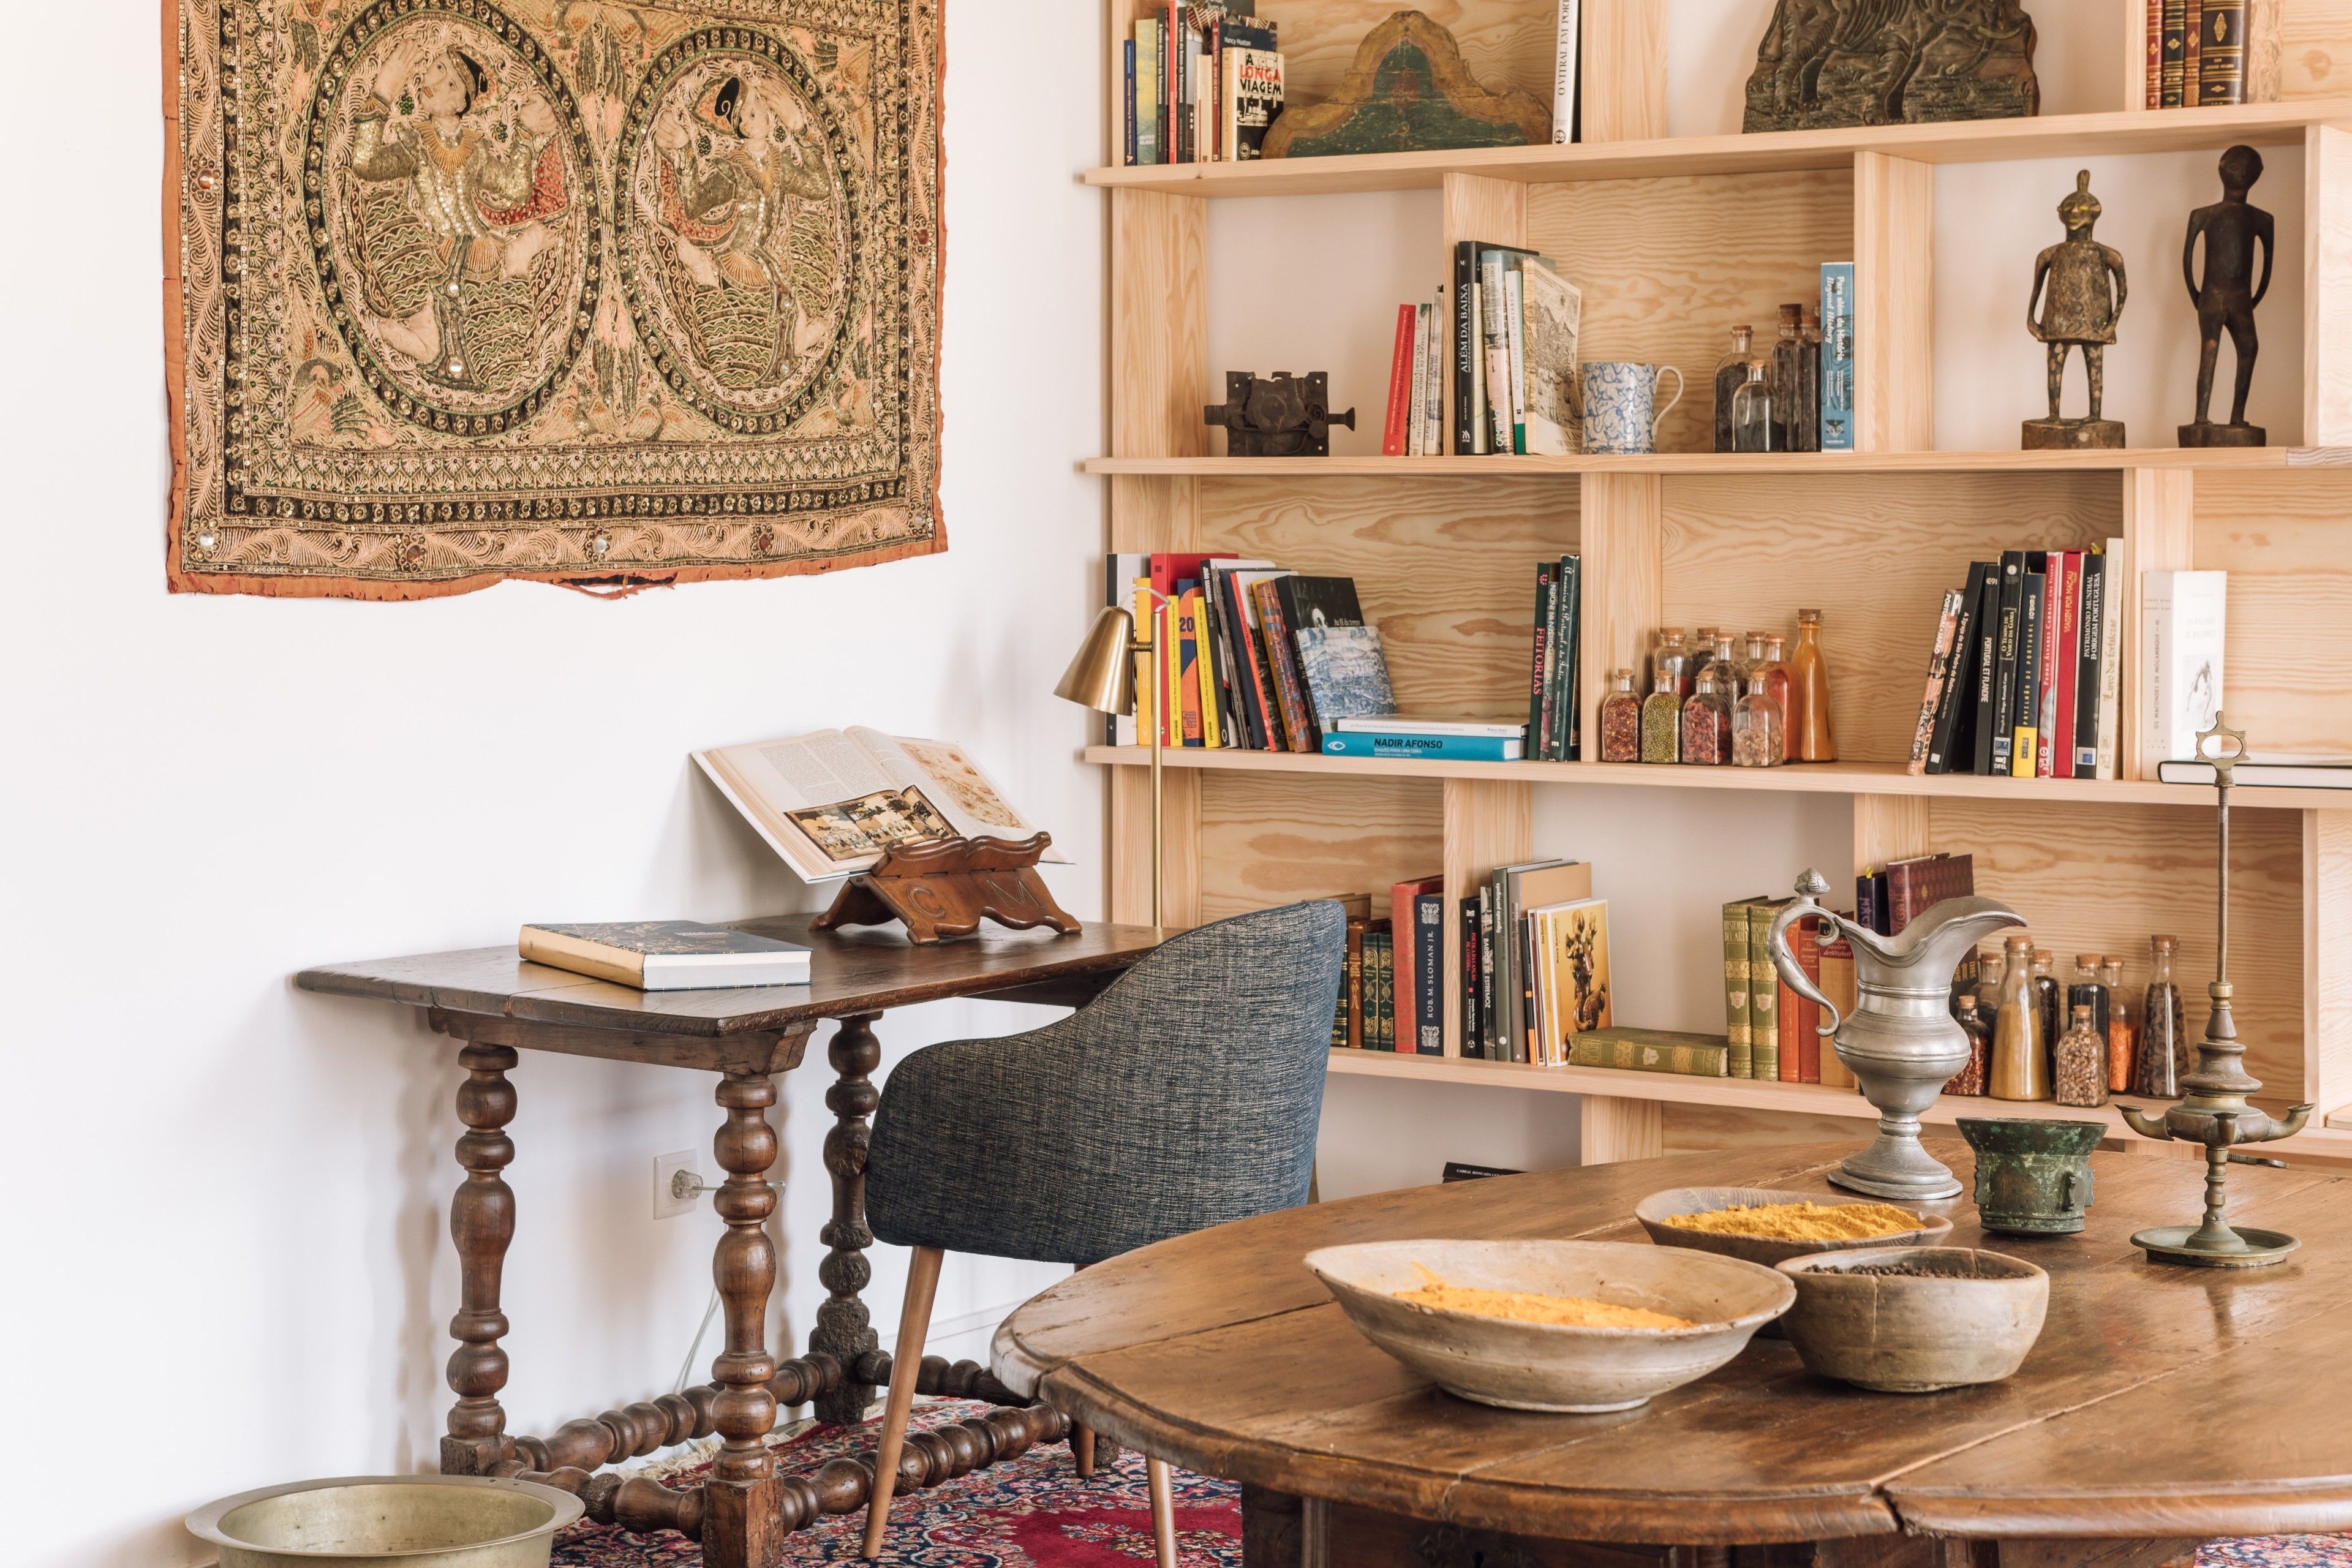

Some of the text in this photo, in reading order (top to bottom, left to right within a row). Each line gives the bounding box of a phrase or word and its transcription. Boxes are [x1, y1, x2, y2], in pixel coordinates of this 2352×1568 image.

[1561, 29, 1568, 44] EM
[1246, 53, 1253, 65] A
[1239, 64, 1281, 83] LONGA
[1240, 78, 1281, 95] VIAGEM
[1825, 276, 1834, 344] Beyond History
[1460, 322, 1468, 338] DA
[1838, 317, 1844, 327] da
[2066, 570, 2075, 594] MACAU
[2092, 573, 2101, 619] PORTUGUESA
[1941, 594, 1951, 628] PORTUGAL
[2064, 609, 2072, 633] VIAGEM
[2083, 575, 2093, 657] PATRIMÓNIO MUNDIAL
[1179, 617, 1194, 632] 20
[1559, 612, 1570, 644] Portugal
[1959, 617, 1969, 635] Igreja
[1546, 621, 1555, 672] PORTUGIESEN
[1934, 631, 1943, 654] JAPÃO
[1983, 637, 1992, 668] PORTUGAL
[2042, 631, 2052, 661] ÁLVARES
[1533, 627, 1545, 695] FEITORIAS
[1559, 650, 1565, 659] da
[1952, 654, 1961, 669] Pedro
[1558, 660, 1569, 680] Índia
[2025, 670, 2031, 679] DE
[1947, 677, 1955, 693] Rates
[1981, 676, 1989, 703] FLANDRE
[2154, 720, 2159, 729] OS
[1374, 738, 1443, 749] NADIR AFONSO
[908, 886, 946, 918] C
[986, 877, 1043, 909] M
[1552, 918, 1561, 947] Ramalho
[1724, 921, 1749, 932] HISTORIA
[1427, 987, 1433, 995] M.
